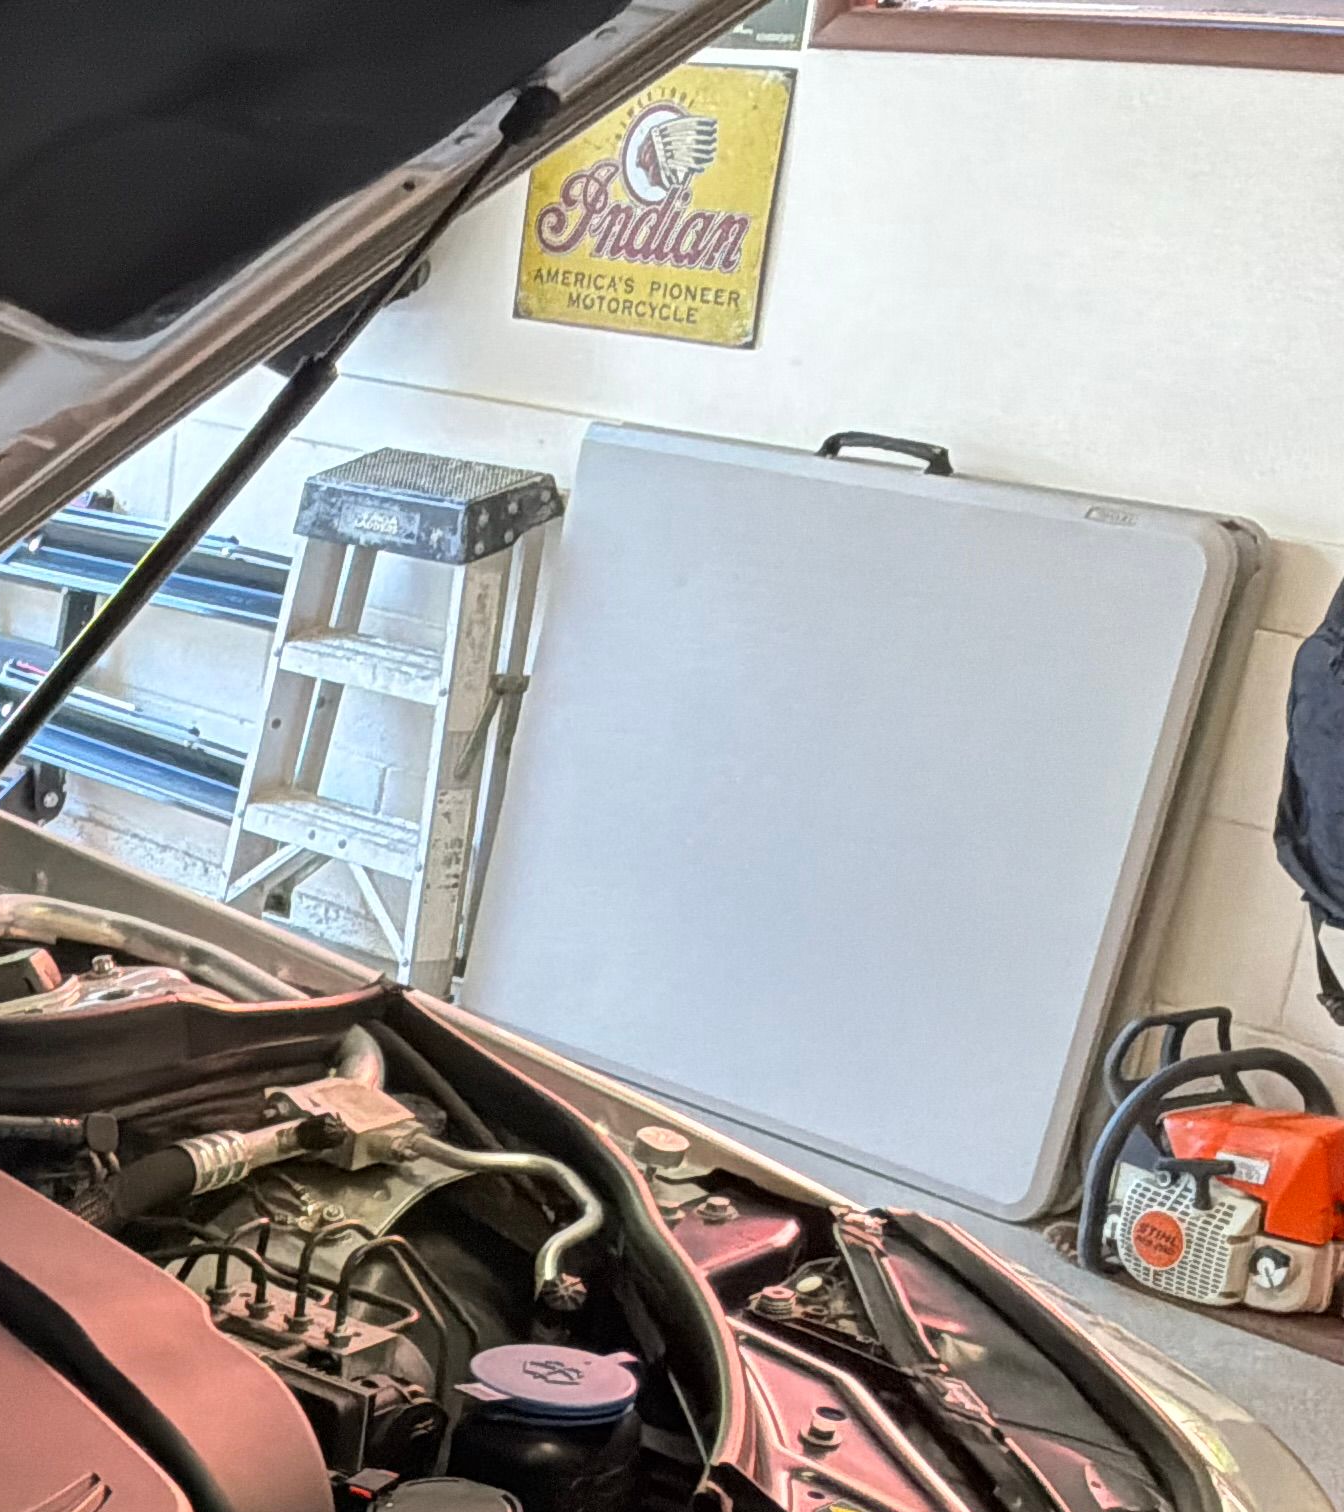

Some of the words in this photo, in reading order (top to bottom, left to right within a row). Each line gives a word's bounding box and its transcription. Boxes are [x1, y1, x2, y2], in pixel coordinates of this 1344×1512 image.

[536, 159, 751, 275] Indian
[533, 267, 635, 294] AMERICA'S
[650, 280, 741, 308] PIONEER
[567, 292, 699, 325] MOTORCYCLE
[1136, 1222, 1177, 1248] STIHL
